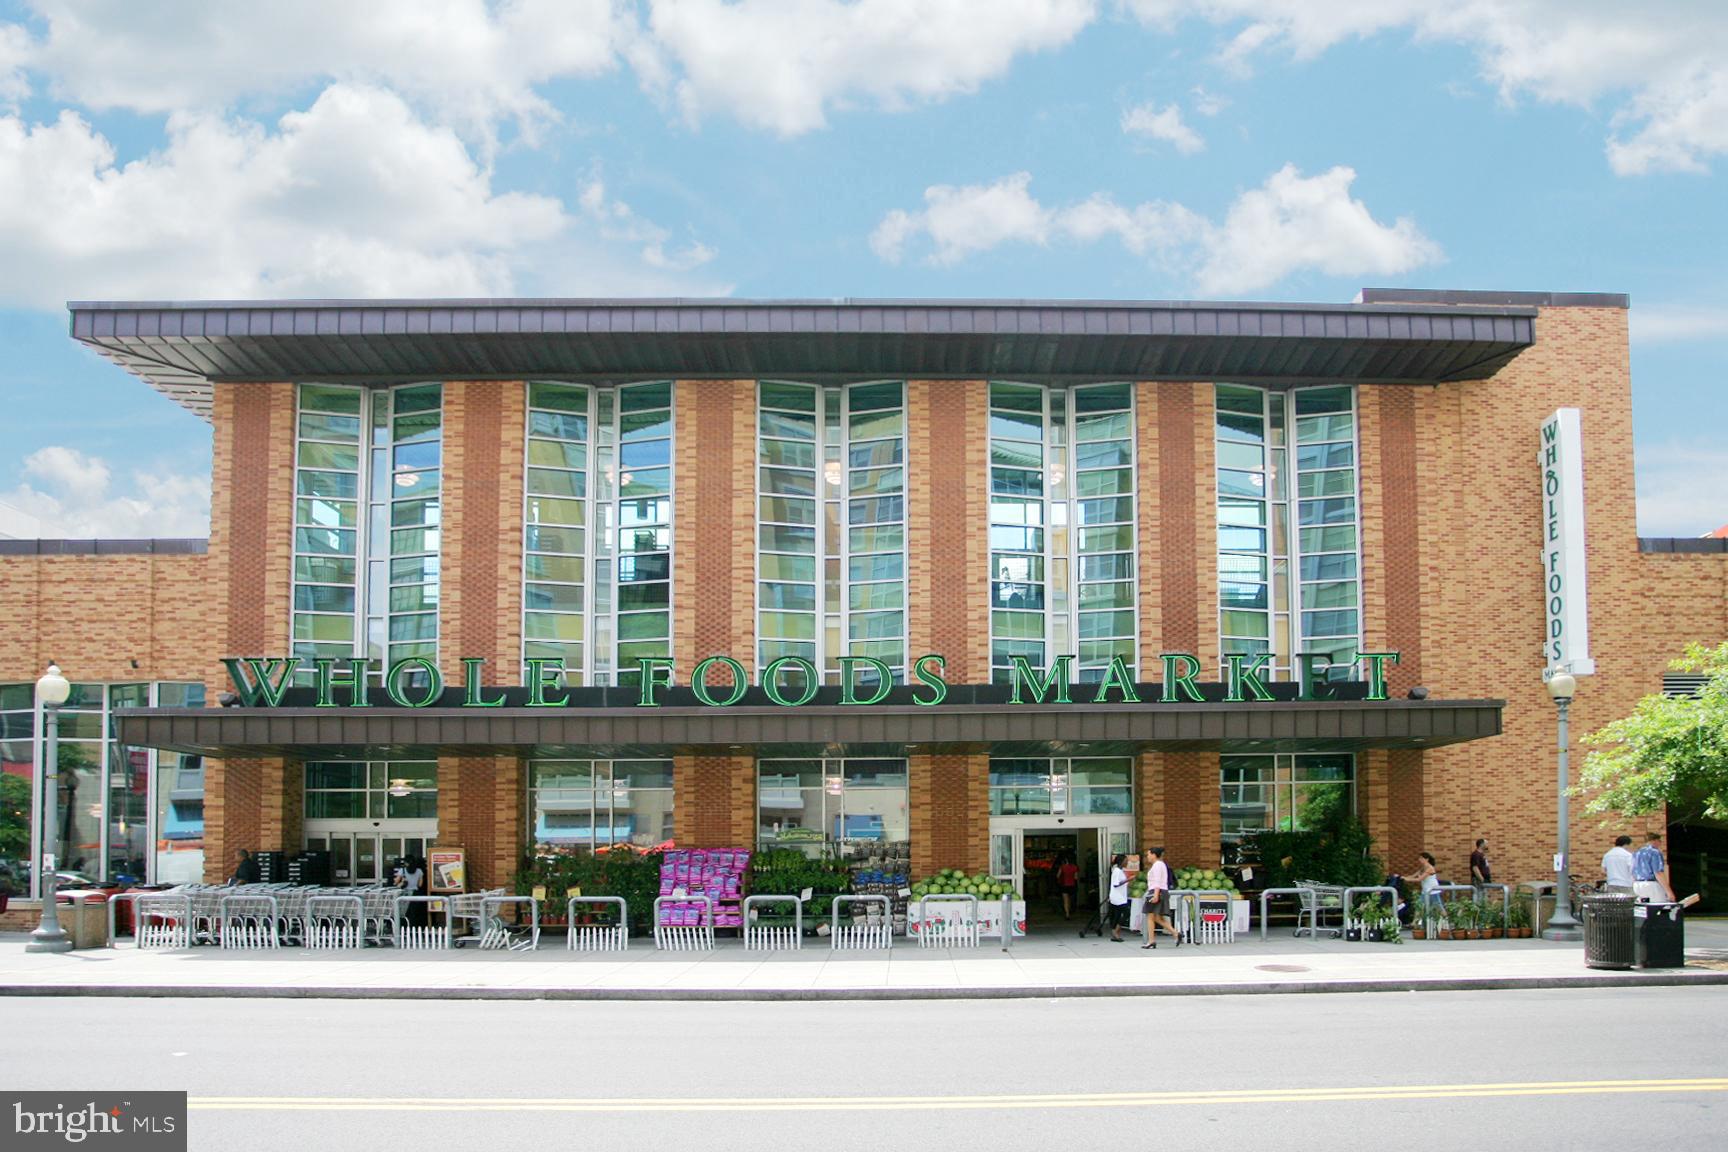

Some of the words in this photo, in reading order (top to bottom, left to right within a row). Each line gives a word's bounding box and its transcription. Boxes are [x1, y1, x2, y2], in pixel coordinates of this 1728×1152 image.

[1542, 420, 1558, 541] WHOLE
[1549, 551, 1562, 661] FOODS
[219, 657, 570, 708] WHOLE
[635, 654, 948, 707] FOODS
[1005, 651, 1400, 705] MARKET
